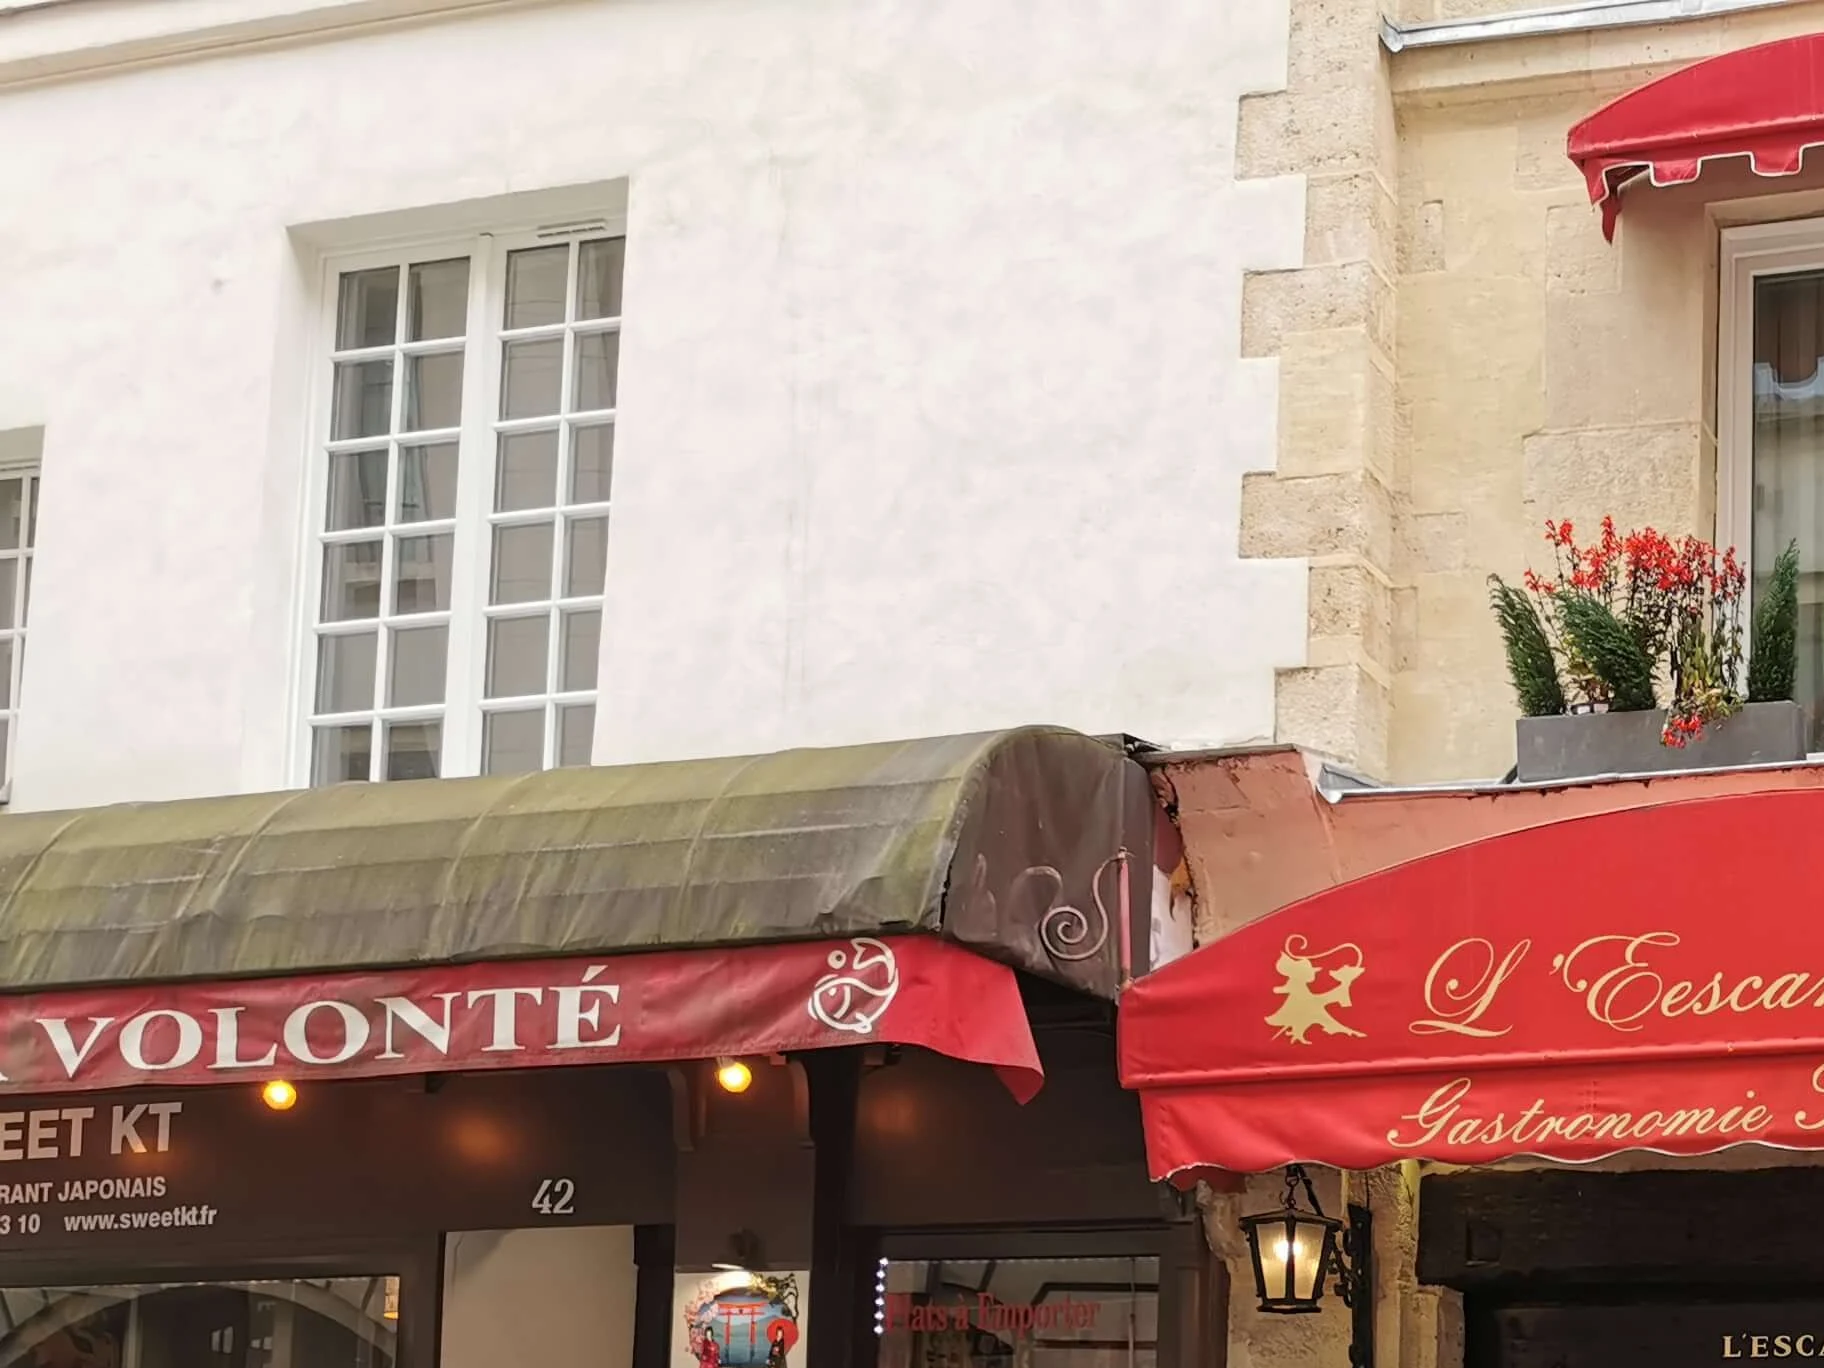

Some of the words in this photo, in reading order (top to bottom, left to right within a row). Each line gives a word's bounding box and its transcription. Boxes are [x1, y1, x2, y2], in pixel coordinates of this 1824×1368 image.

[36, 965, 622, 1079] VOLONTÉ
[110, 1102, 183, 1155] KT
[1386, 1077, 1773, 1149] Gastronomie
[57, 1176, 167, 1202] JAPONAIS
[531, 1178, 576, 1215] 42
[17, 1213, 41, 1234] 10
